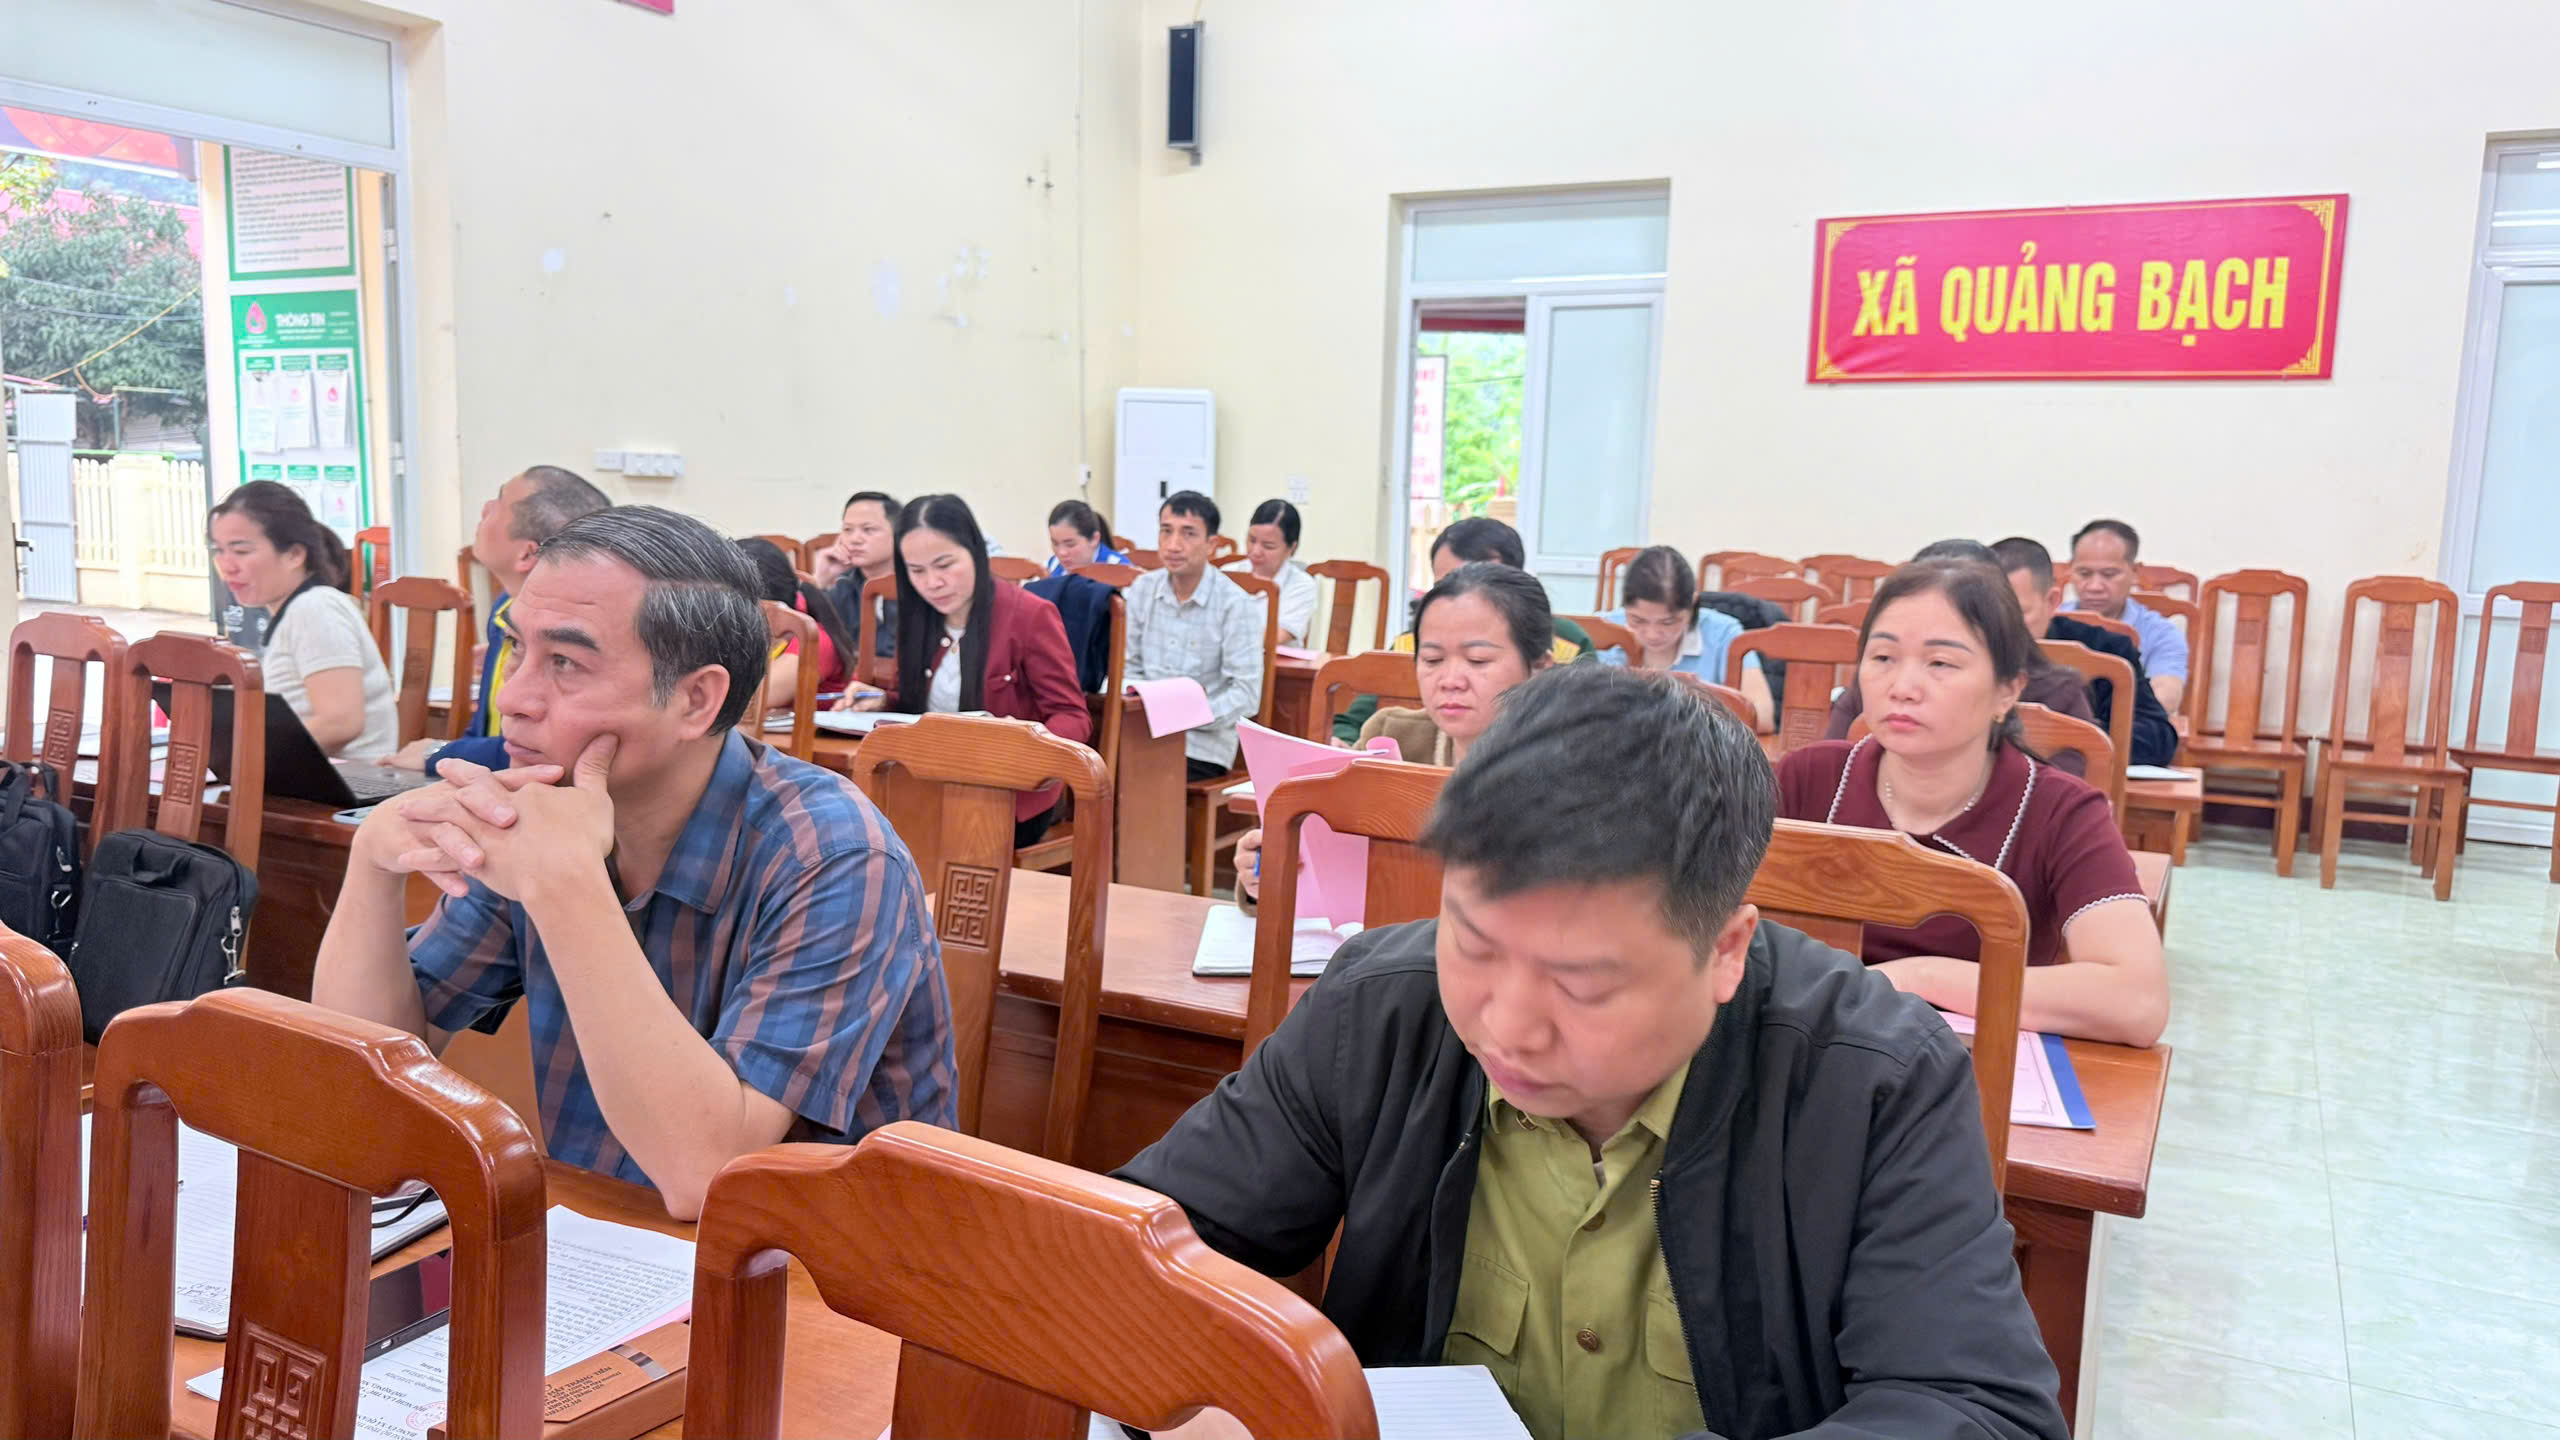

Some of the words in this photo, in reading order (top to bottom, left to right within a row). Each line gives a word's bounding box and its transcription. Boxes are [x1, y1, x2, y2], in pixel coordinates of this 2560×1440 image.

[1852, 254, 1919, 336] XÃ
[1939, 240, 2117, 343] QUẢNG
[2137, 256, 2290, 348] BẠCH
